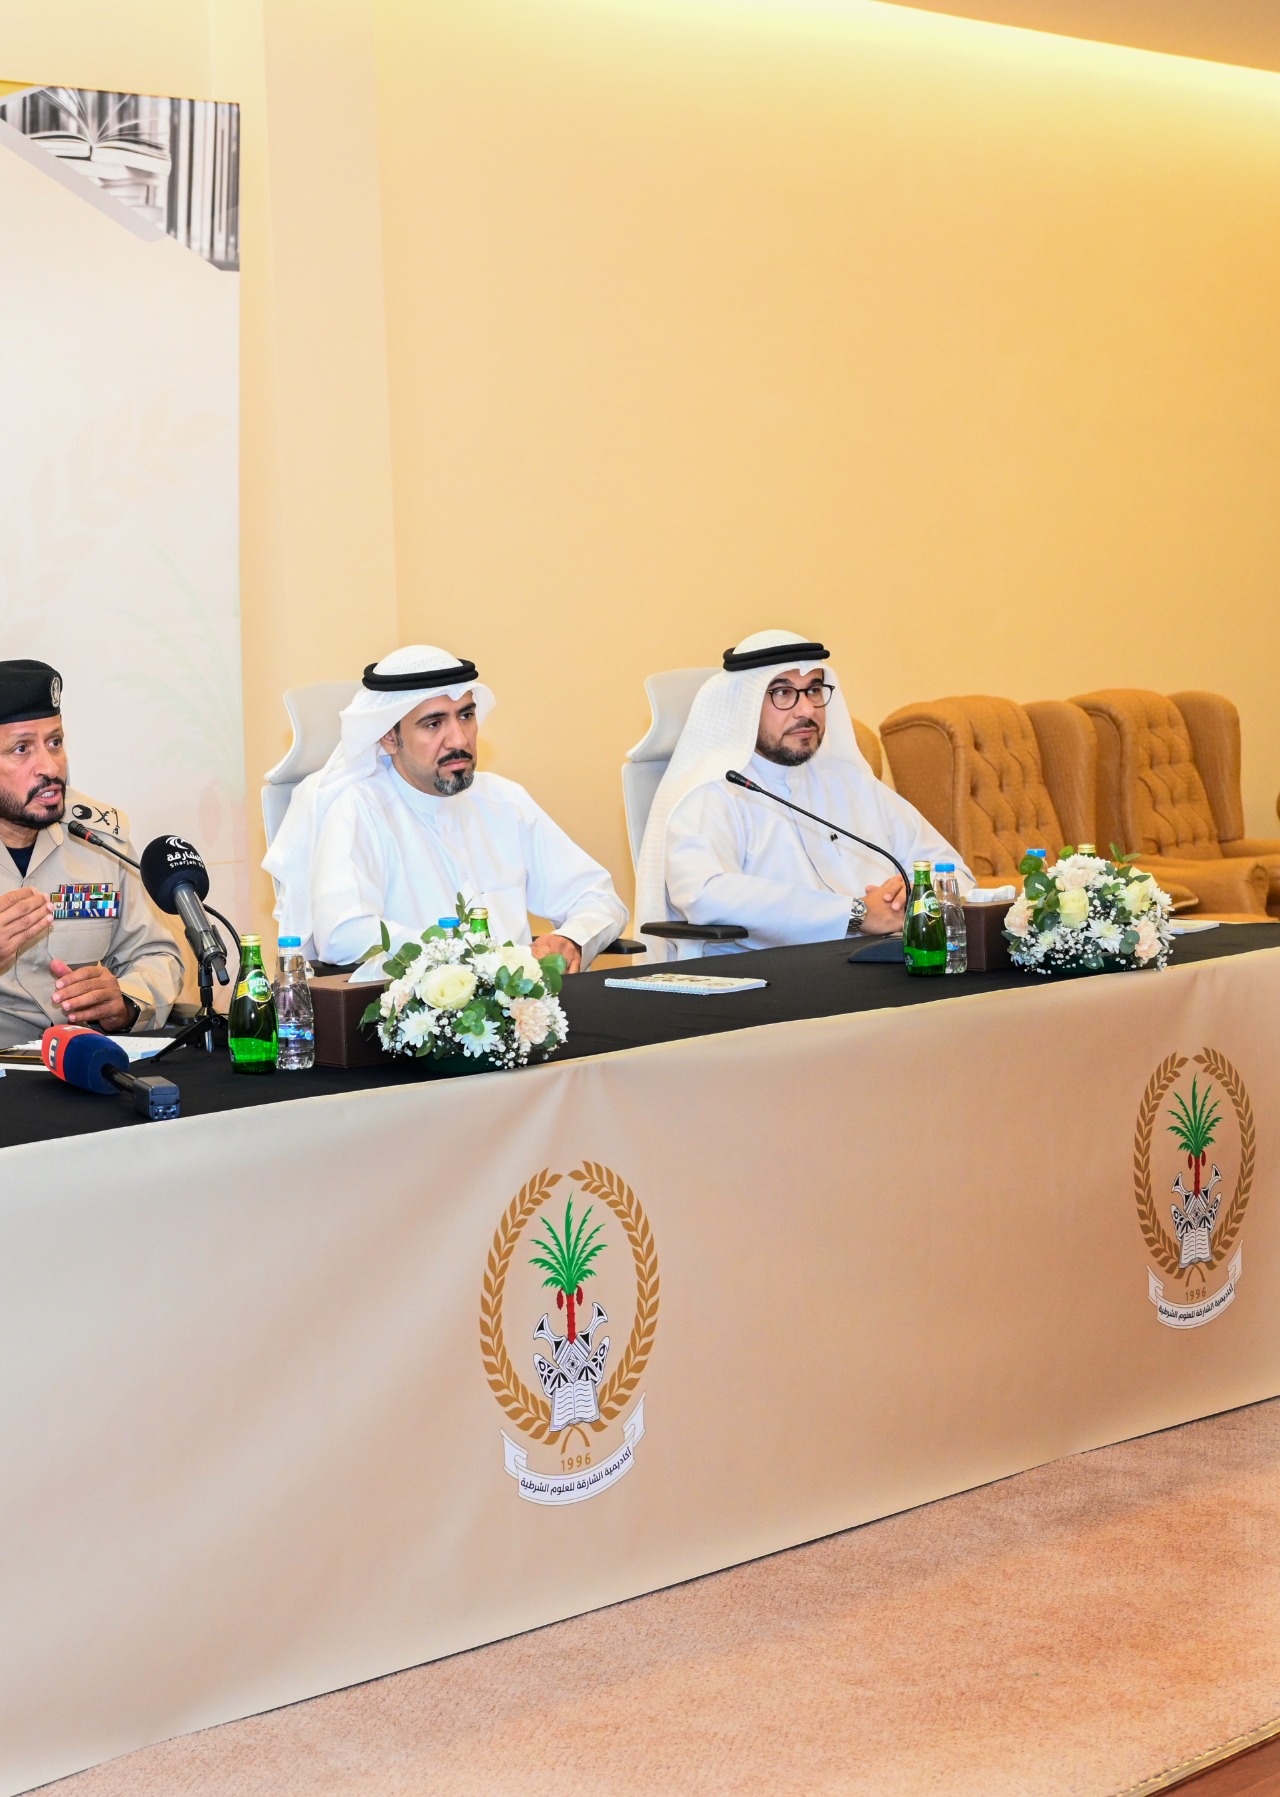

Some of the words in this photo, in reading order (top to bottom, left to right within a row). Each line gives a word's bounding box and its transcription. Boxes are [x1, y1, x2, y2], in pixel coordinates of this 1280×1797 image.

[170, 860, 196, 868] Sharjah
[1185, 1287, 1206, 1301] 1996
[561, 1453, 591, 1472] 1996
[604, 1446, 632, 1476] أكاديمية
[520, 1478, 549, 1493] الشرطية
[551, 1483, 575, 1495] للعلوم
[577, 1473, 603, 1491] الشارقة
